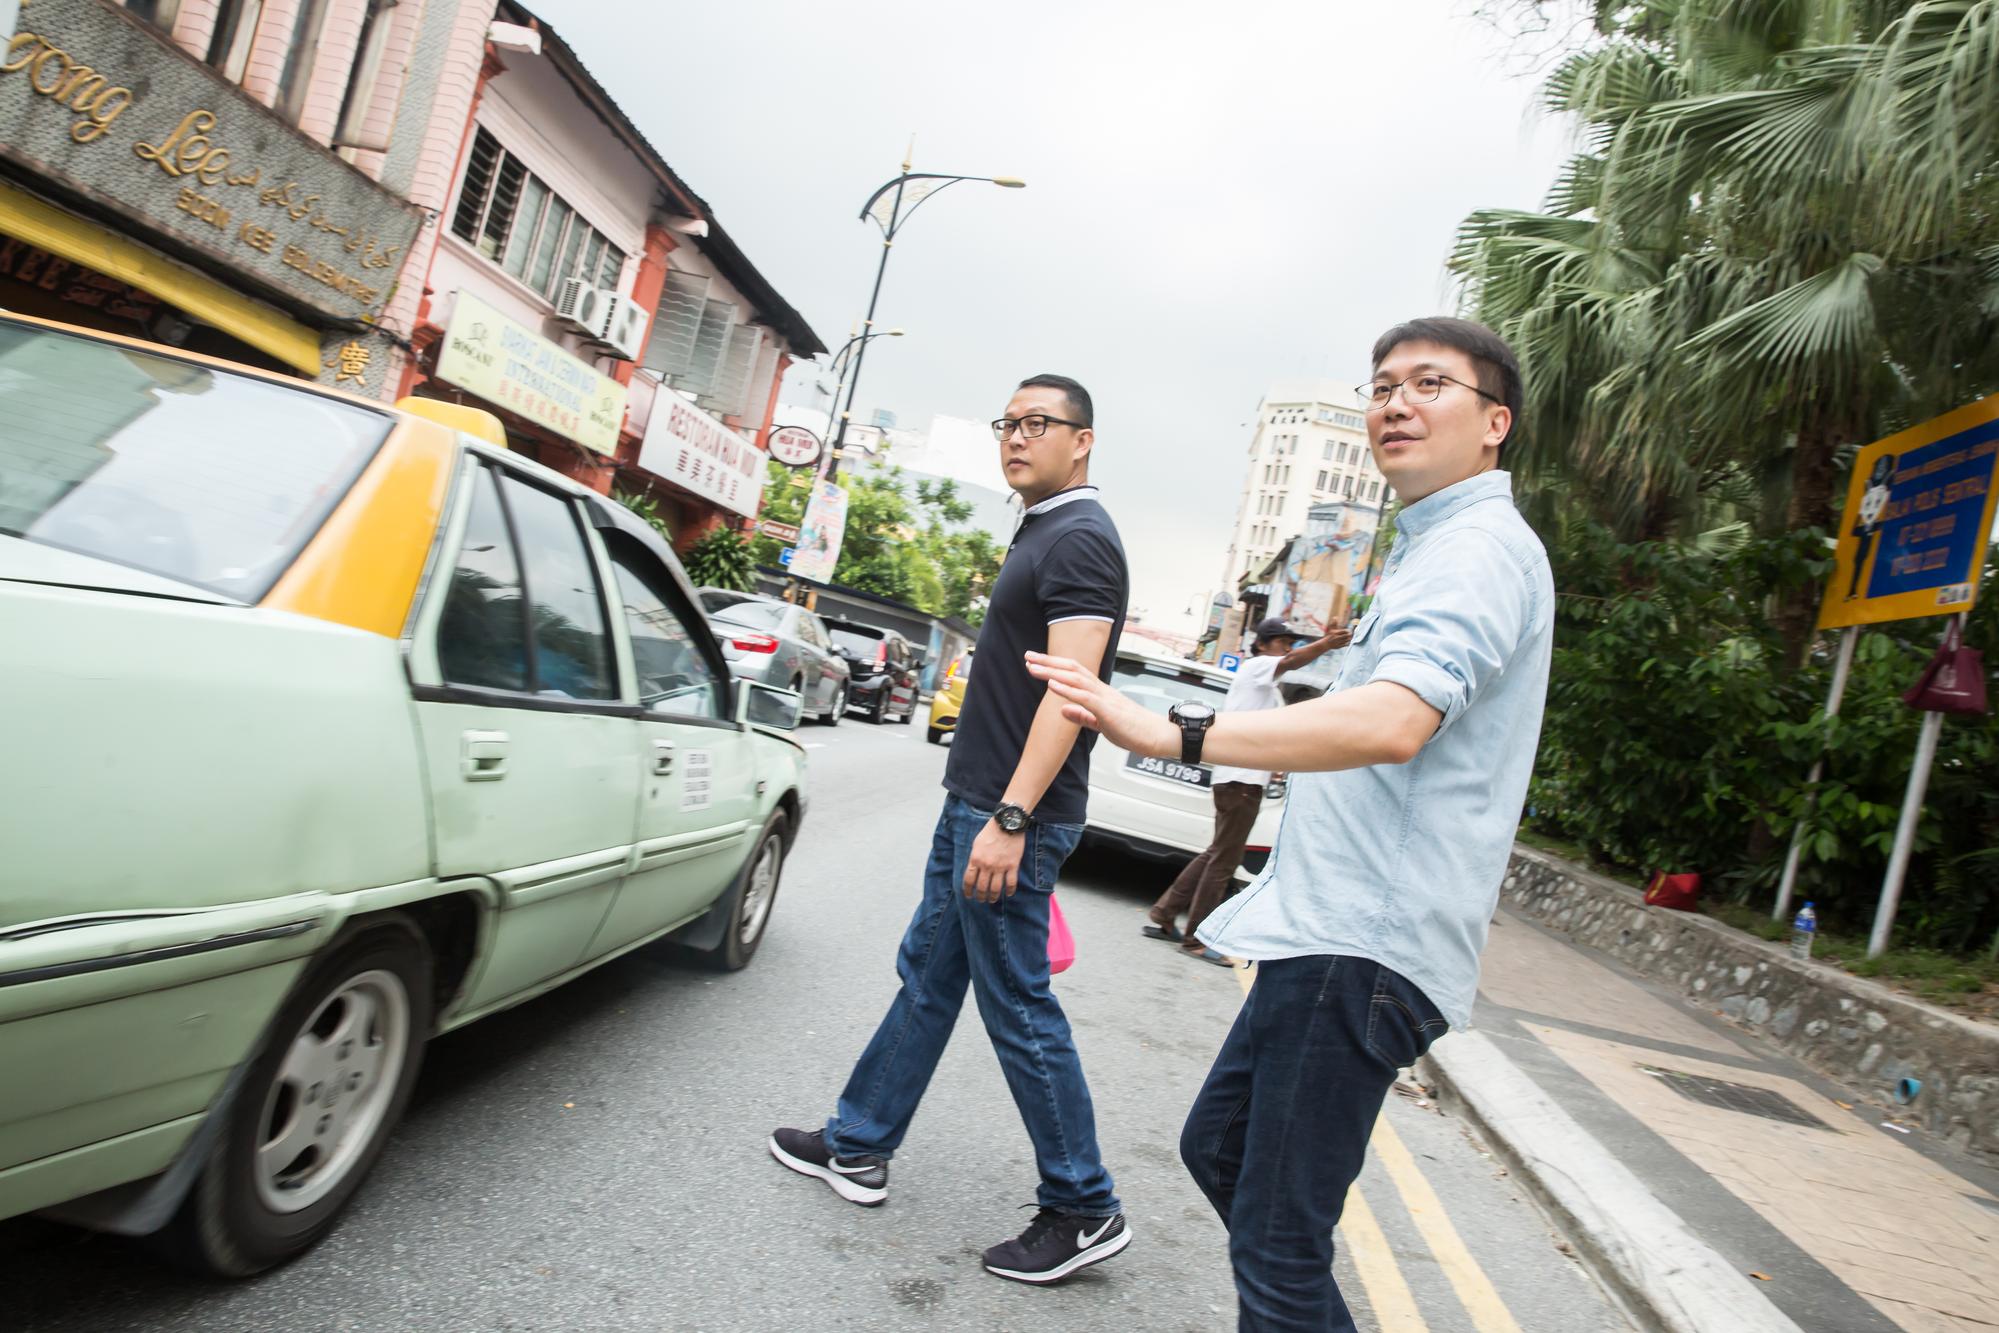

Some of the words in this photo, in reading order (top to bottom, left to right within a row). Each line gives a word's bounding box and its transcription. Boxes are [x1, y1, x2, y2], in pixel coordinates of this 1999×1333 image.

[132, 109, 230, 186] Lee
[240, 219, 277, 255] KEE
[324, 339, 371, 386] 廣
[667, 402, 722, 459] RESTORAN
[1222, 656, 1236, 670] P
[1136, 757, 1164, 774] JSA
[1165, 763, 1202, 783] 9796
